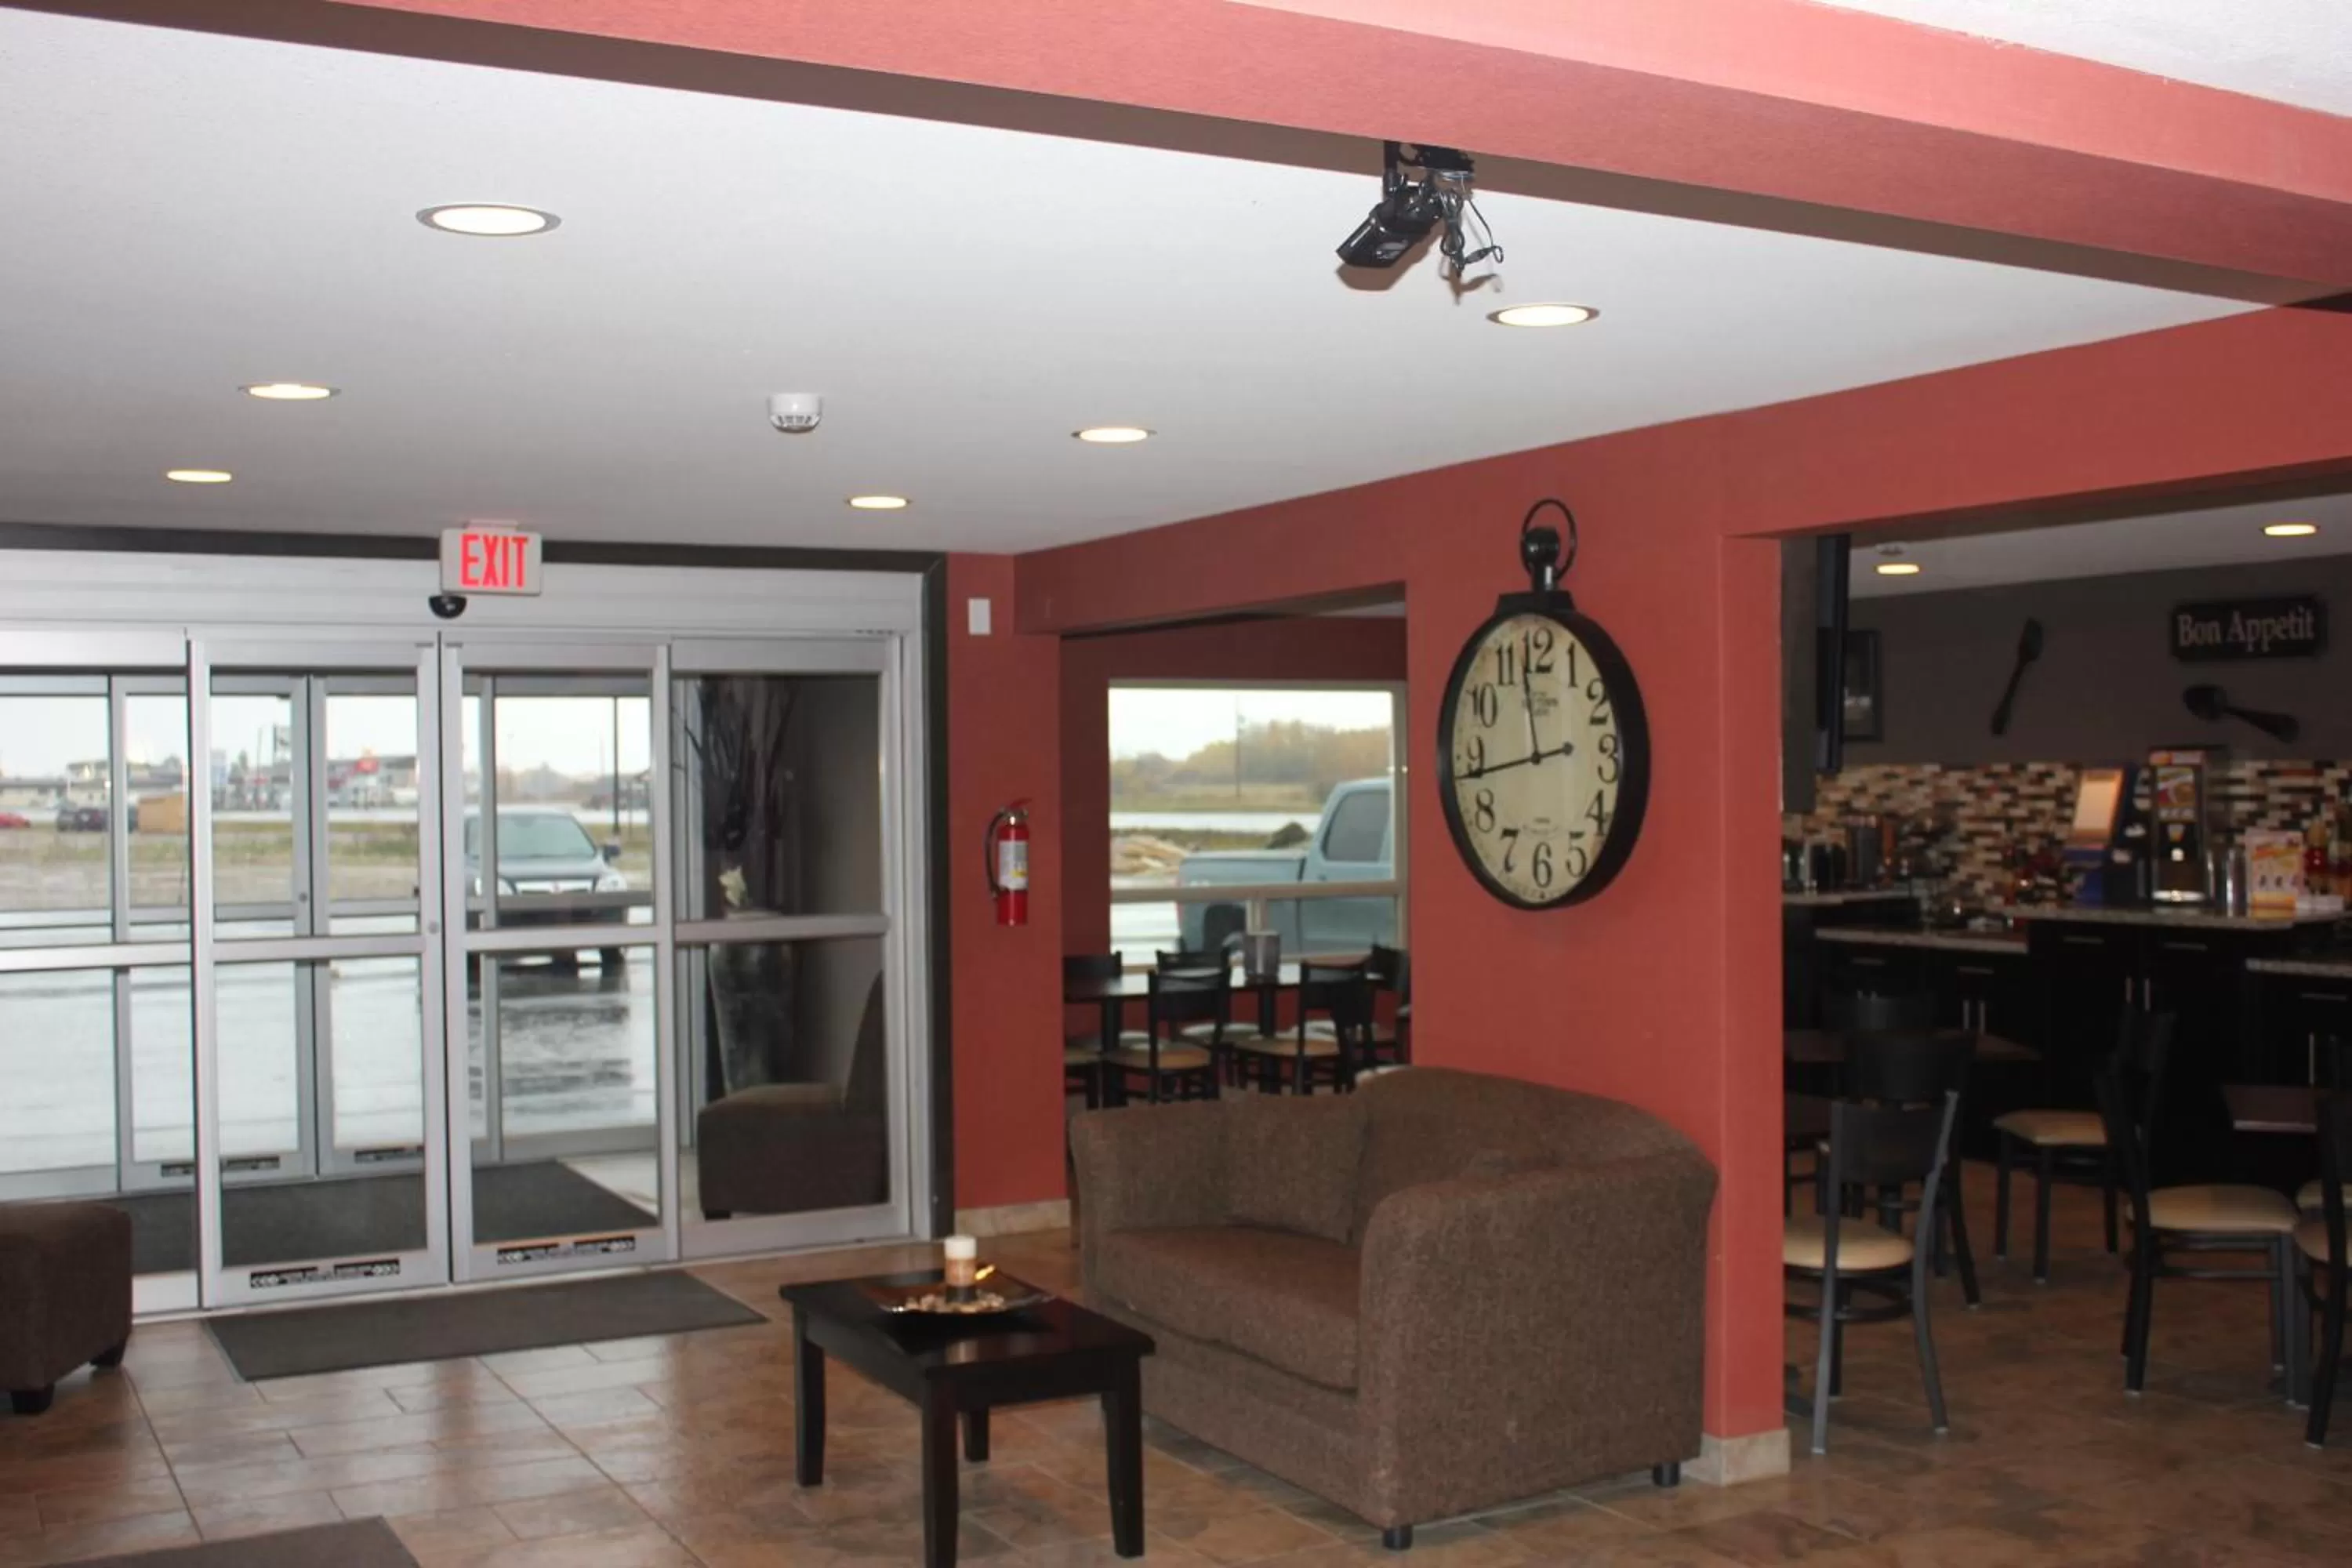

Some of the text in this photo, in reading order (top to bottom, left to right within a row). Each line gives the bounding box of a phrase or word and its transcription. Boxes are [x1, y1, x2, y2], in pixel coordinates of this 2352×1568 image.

[460, 533, 528, 588] EXIT
[1522, 628, 1554, 674] 12
[2176, 604, 2315, 653] Bon Appetit
[1496, 641, 1514, 687] 11
[1566, 641, 1577, 688] 1
[1468, 682, 1497, 728] 10
[1585, 677, 1609, 726] 2
[1467, 735, 1485, 776] 9
[1598, 734, 1618, 784] 3
[1475, 789, 1495, 833] 8
[1585, 789, 1611, 837] 4
[1500, 828, 1520, 873] 7
[1532, 841, 1552, 888] 6
[1565, 831, 1586, 878] 5
